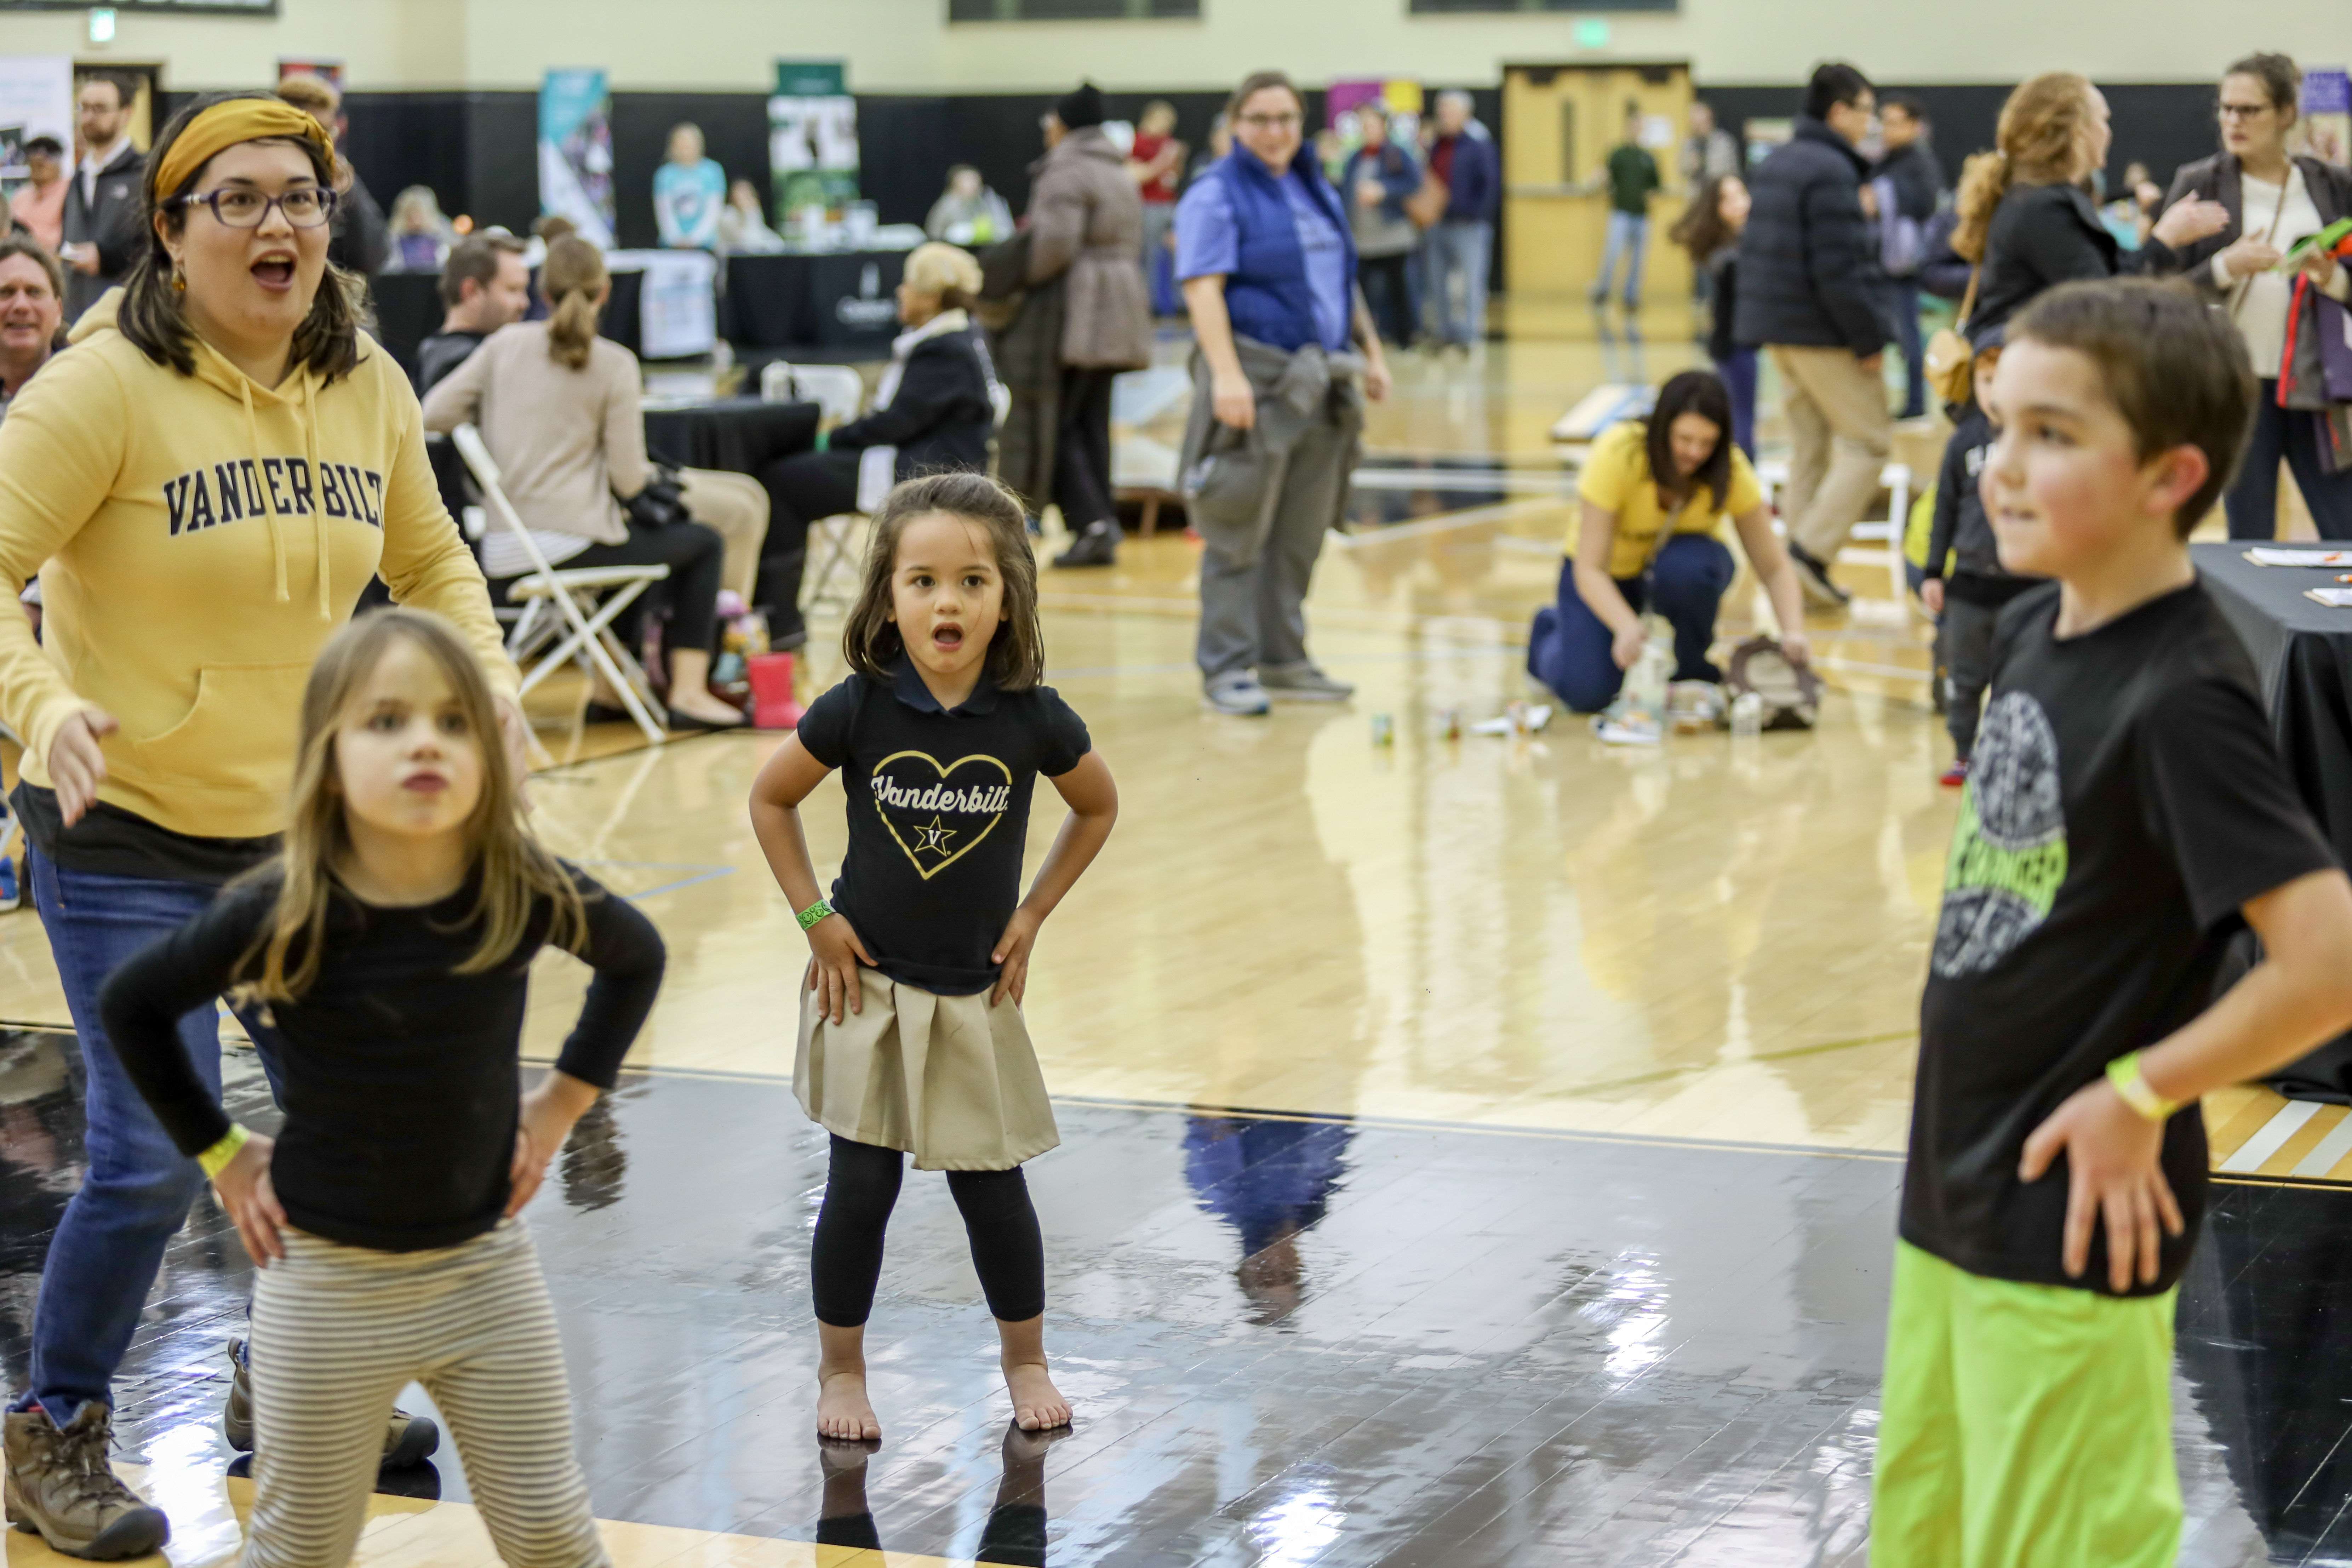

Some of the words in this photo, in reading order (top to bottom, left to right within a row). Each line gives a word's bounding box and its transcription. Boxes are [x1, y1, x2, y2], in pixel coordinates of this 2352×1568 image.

[163, 457, 385, 537] VANDERBILT
[871, 775, 1010, 813] Vanderbilt
[928, 830, 941, 845] V
